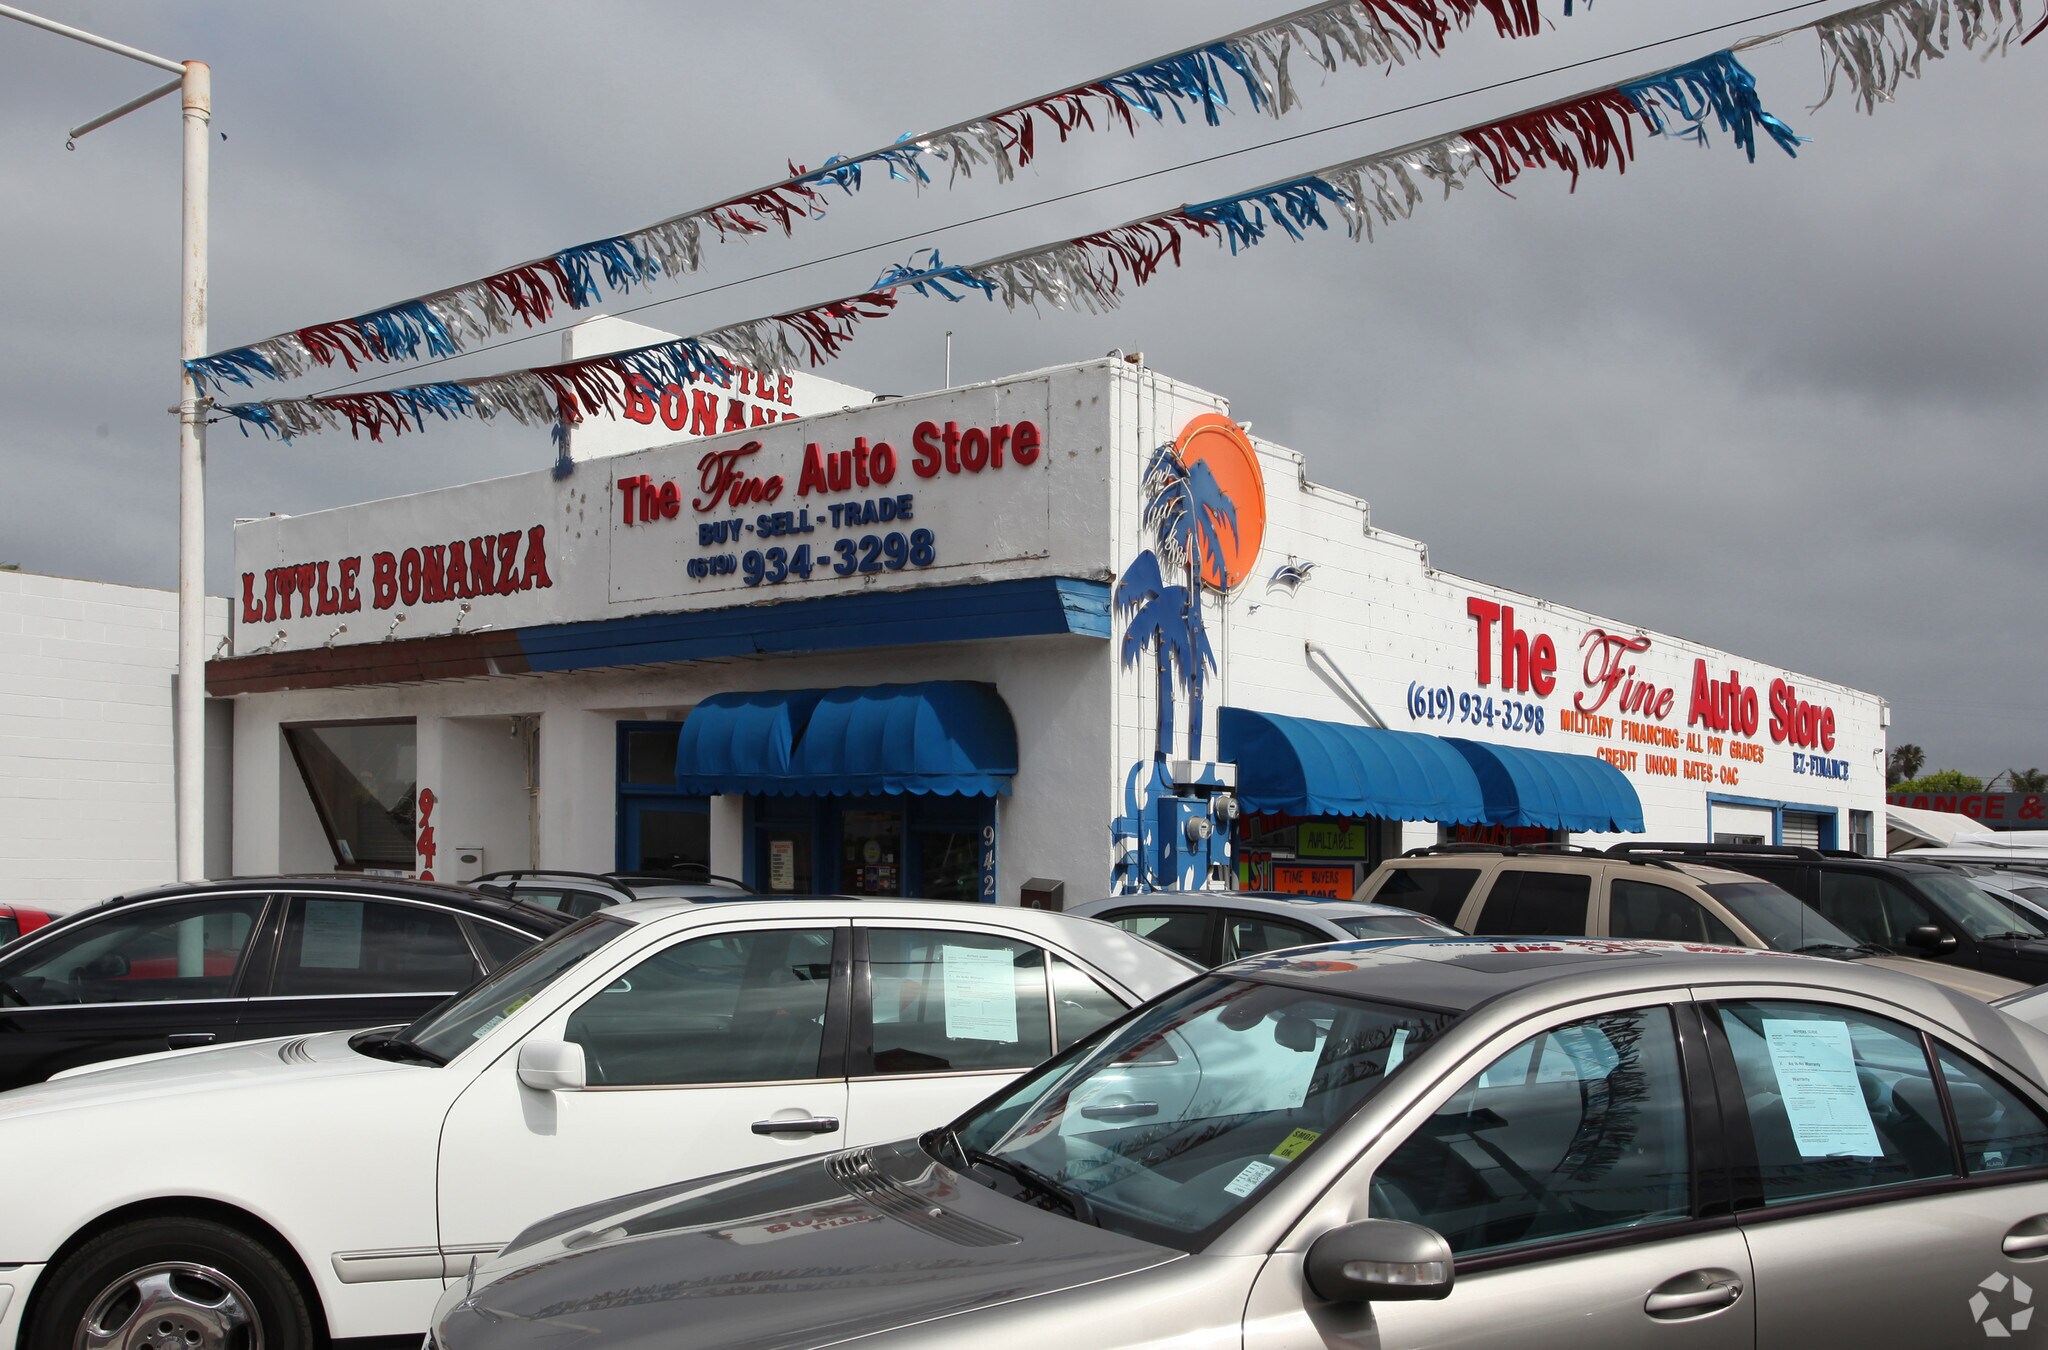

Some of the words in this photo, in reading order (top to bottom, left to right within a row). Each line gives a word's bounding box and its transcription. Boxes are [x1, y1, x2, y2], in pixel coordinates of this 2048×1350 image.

[617, 475, 681, 525] The
[693, 441, 785, 513] Fine
[797, 437, 896, 496] Auto
[912, 421, 1041, 479] Store
[242, 556, 361, 624] LITTLE
[373, 524, 553, 610] BONANZA
[687, 553, 737, 579] (619)
[742, 528, 935, 586] 934-3298
[1467, 596, 1557, 696] The
[1574, 628, 1674, 719] Fine
[1688, 658, 1759, 737] Auto
[1769, 677, 1836, 753] Store
[1407, 680, 1455, 724] (619)
[1459, 692, 1545, 735] 934-3298
[1560, 709, 1614, 739] MILITARY
[1707, 736, 1724, 757] PAY
[1730, 741, 1765, 765] GRADES
[1597, 746, 1638, 773] CREDIT
[1645, 753, 1678, 777] UNION
[2018, 794, 2047, 820] &
[983, 825, 995, 896] 942
[1282, 870, 1303, 885] TIME
[1311, 870, 1339, 885] BUYERS
[1280, 1148, 1293, 1157] OK
[1293, 1130, 1316, 1142] SMOG
